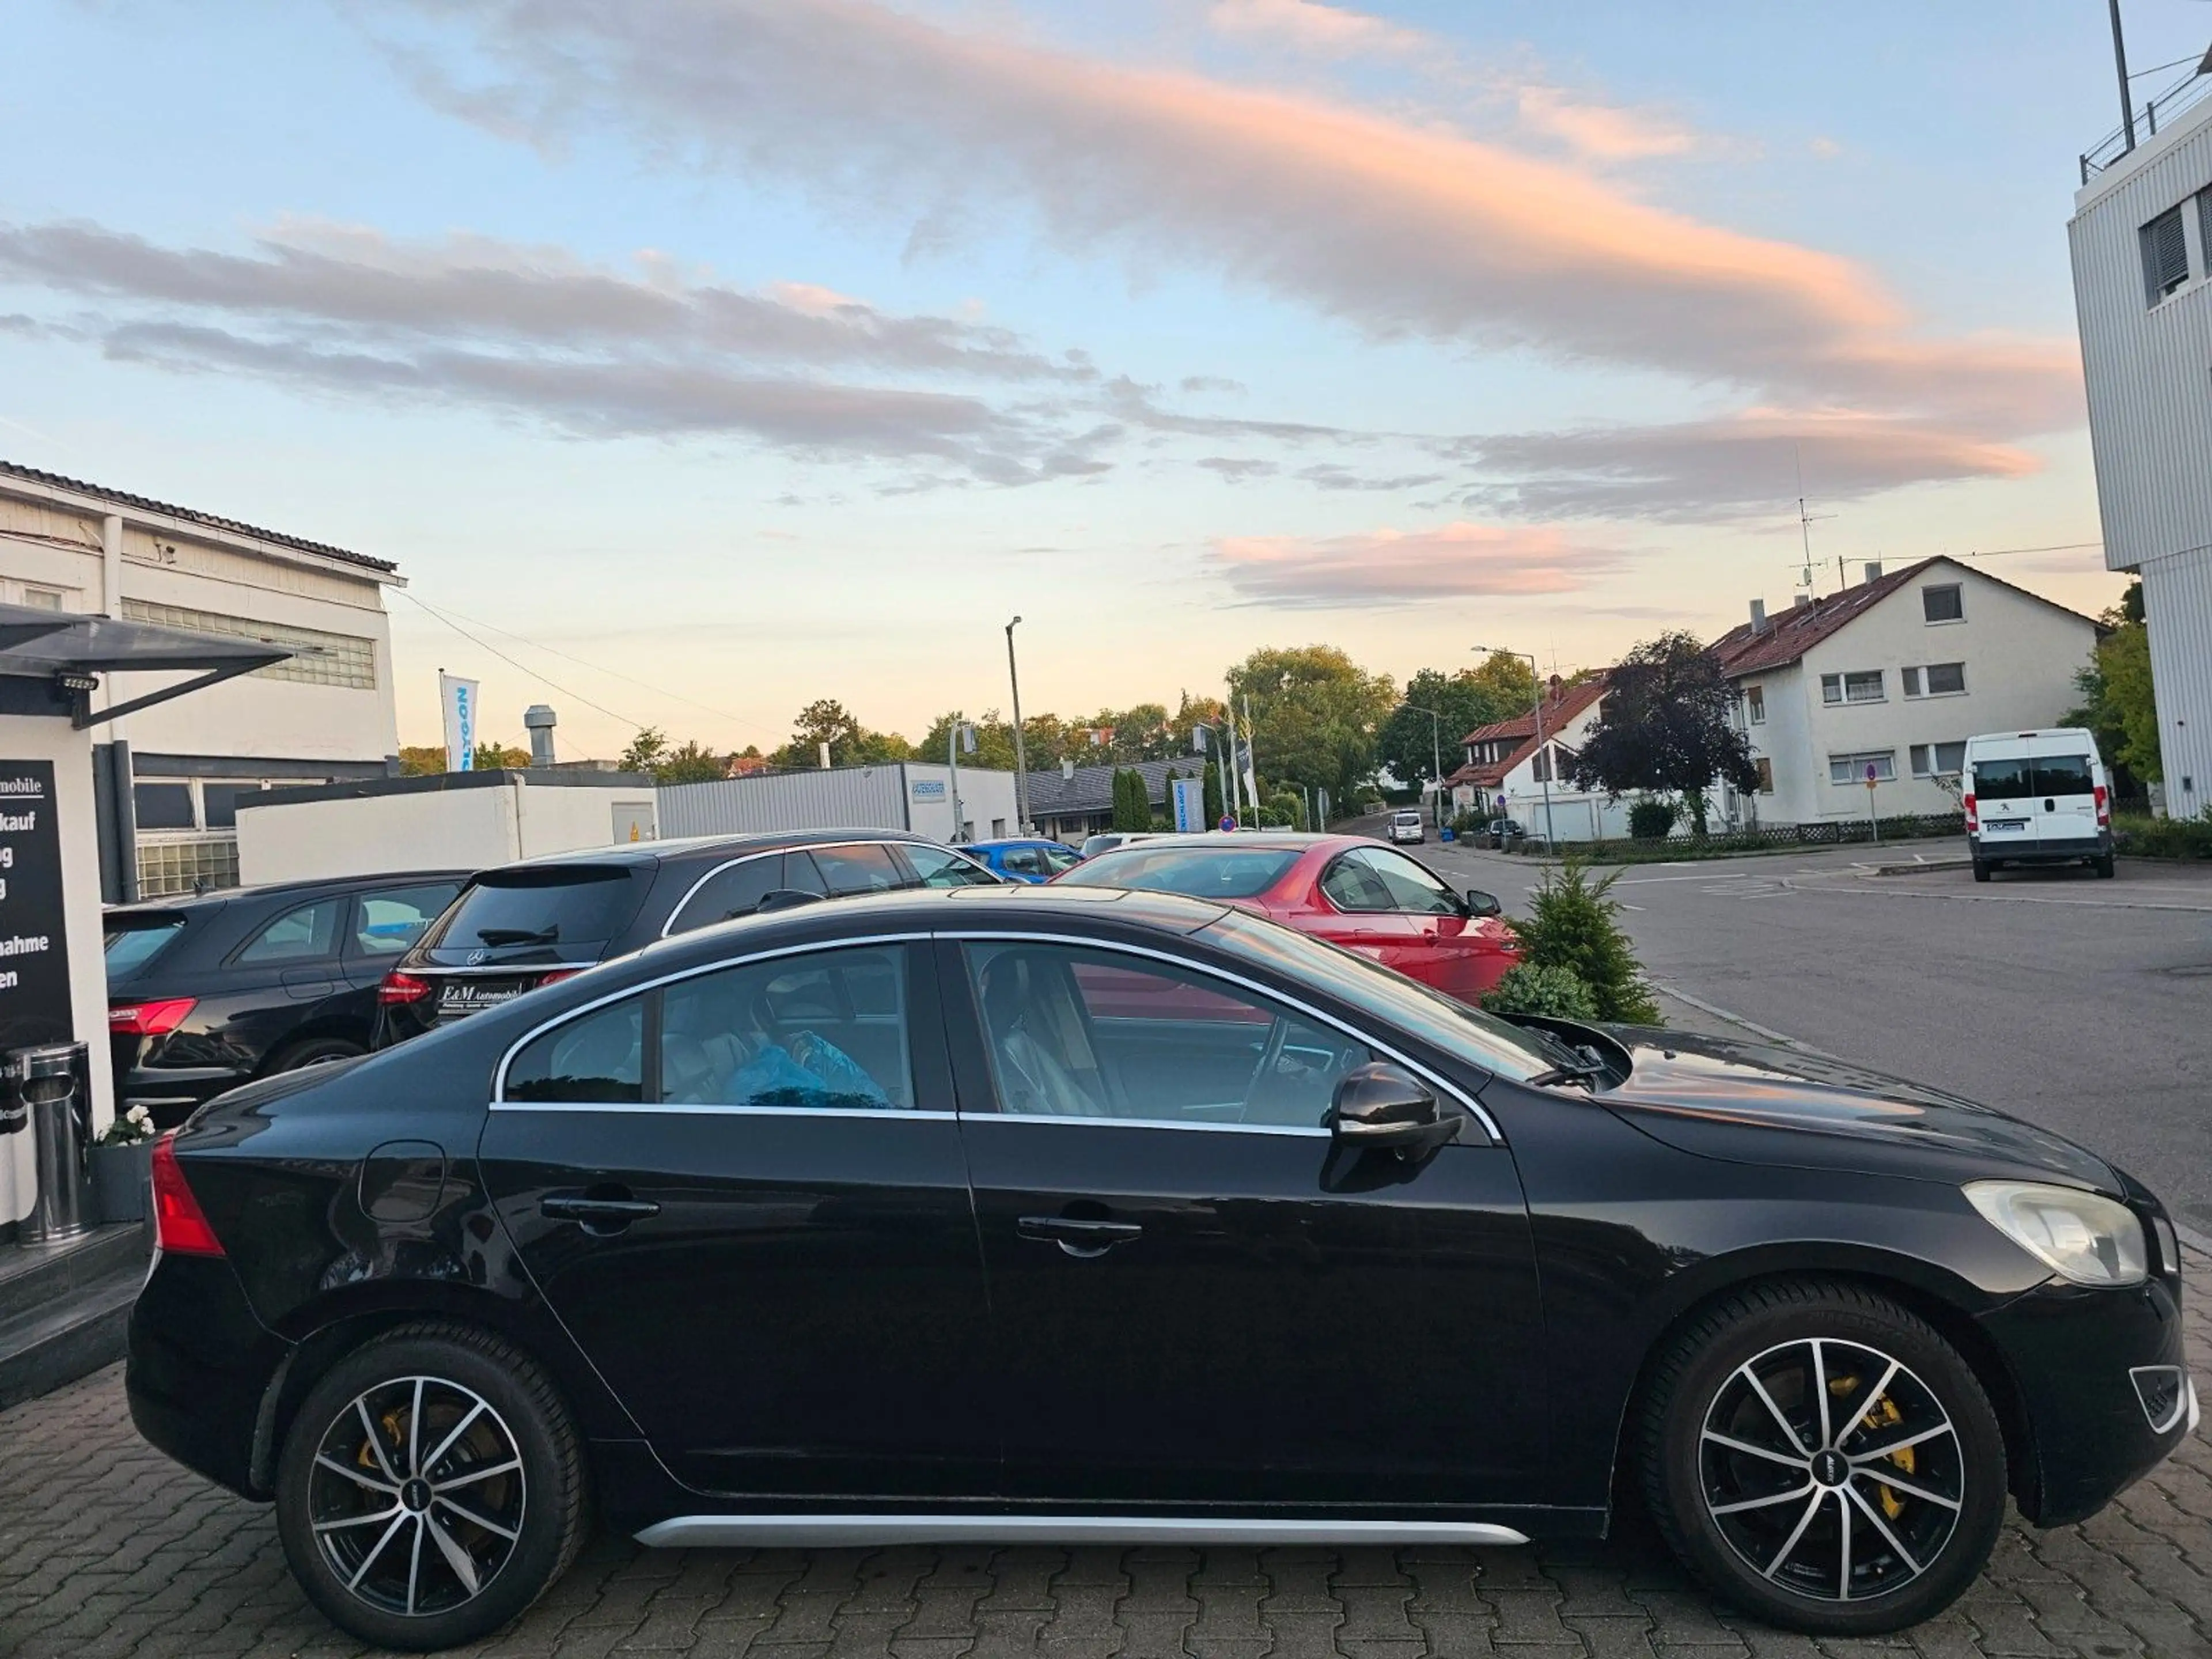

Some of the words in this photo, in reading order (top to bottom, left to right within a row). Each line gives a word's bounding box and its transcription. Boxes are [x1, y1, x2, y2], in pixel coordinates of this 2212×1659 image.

[0, 811, 35, 831] kauf
[0, 847, 13, 868] g
[442, 986, 475, 1001] E&M
